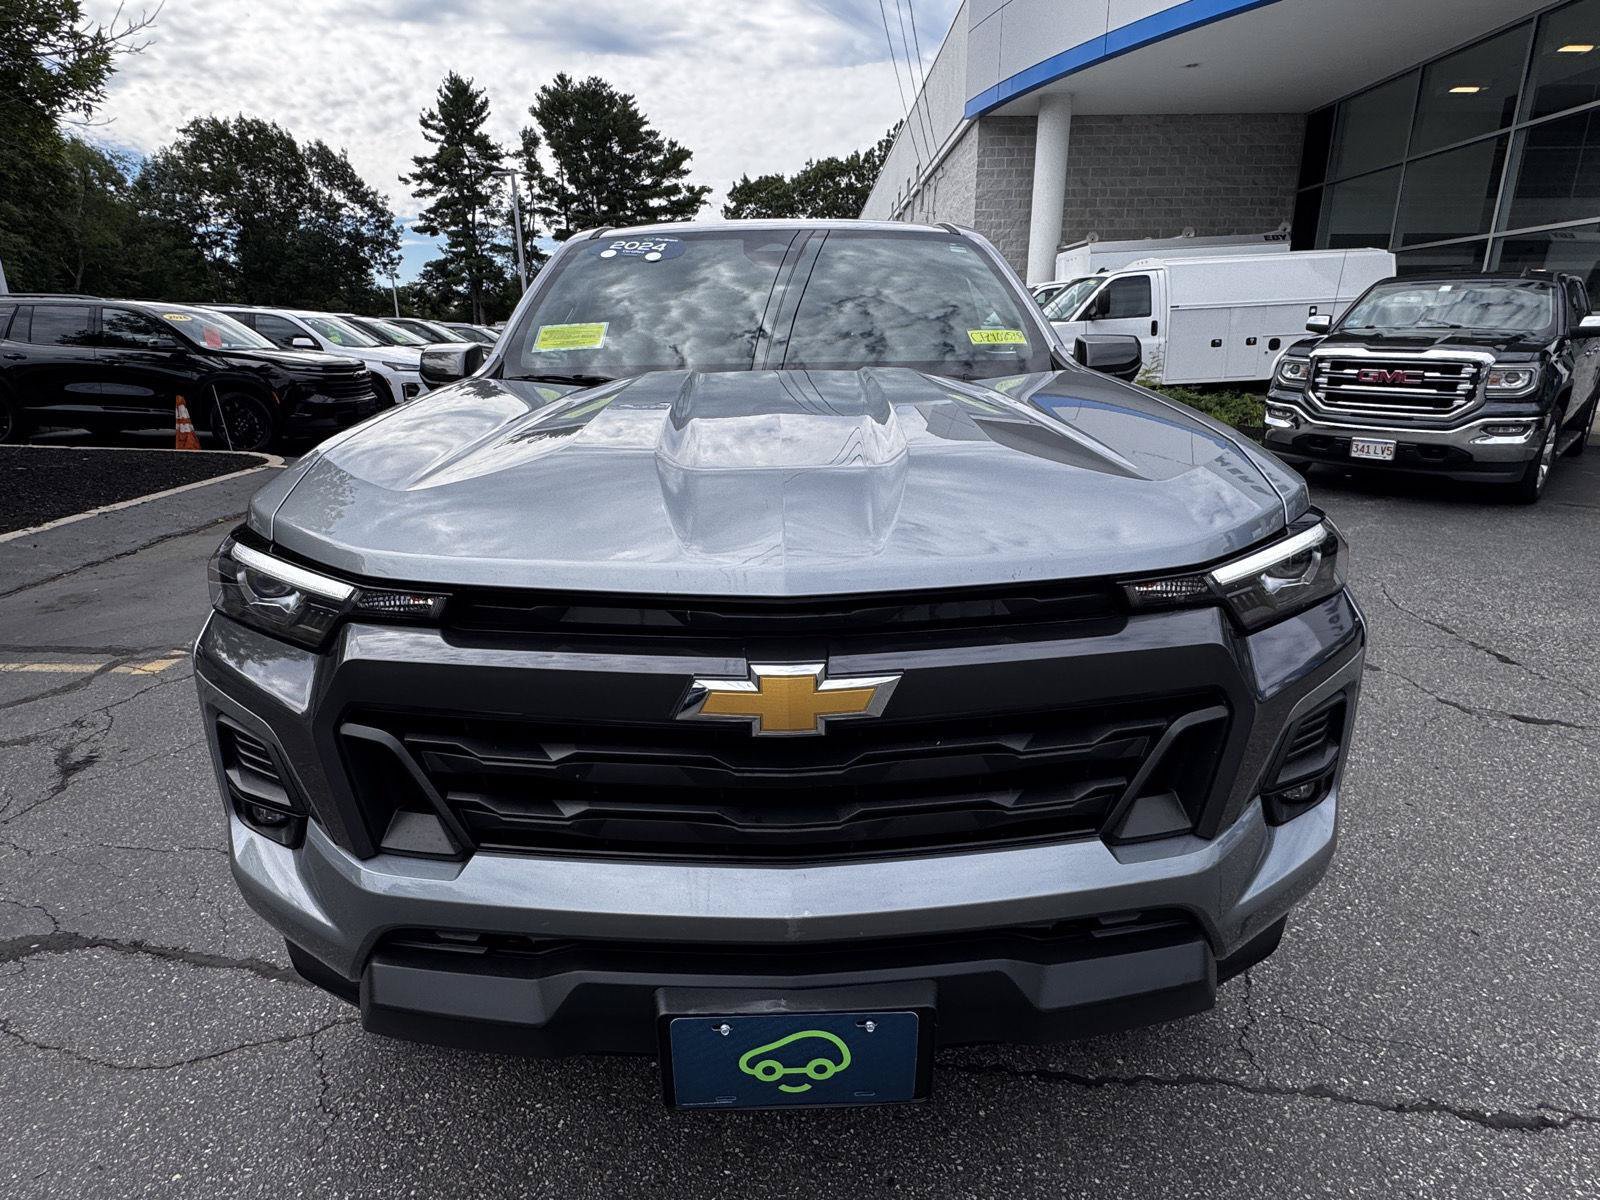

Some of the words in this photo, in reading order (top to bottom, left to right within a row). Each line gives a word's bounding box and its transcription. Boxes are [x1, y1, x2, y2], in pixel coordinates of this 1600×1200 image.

[609, 241, 667, 252] 2024
[1358, 368, 1424, 384] GMC
[1352, 443, 1371, 455] 341
